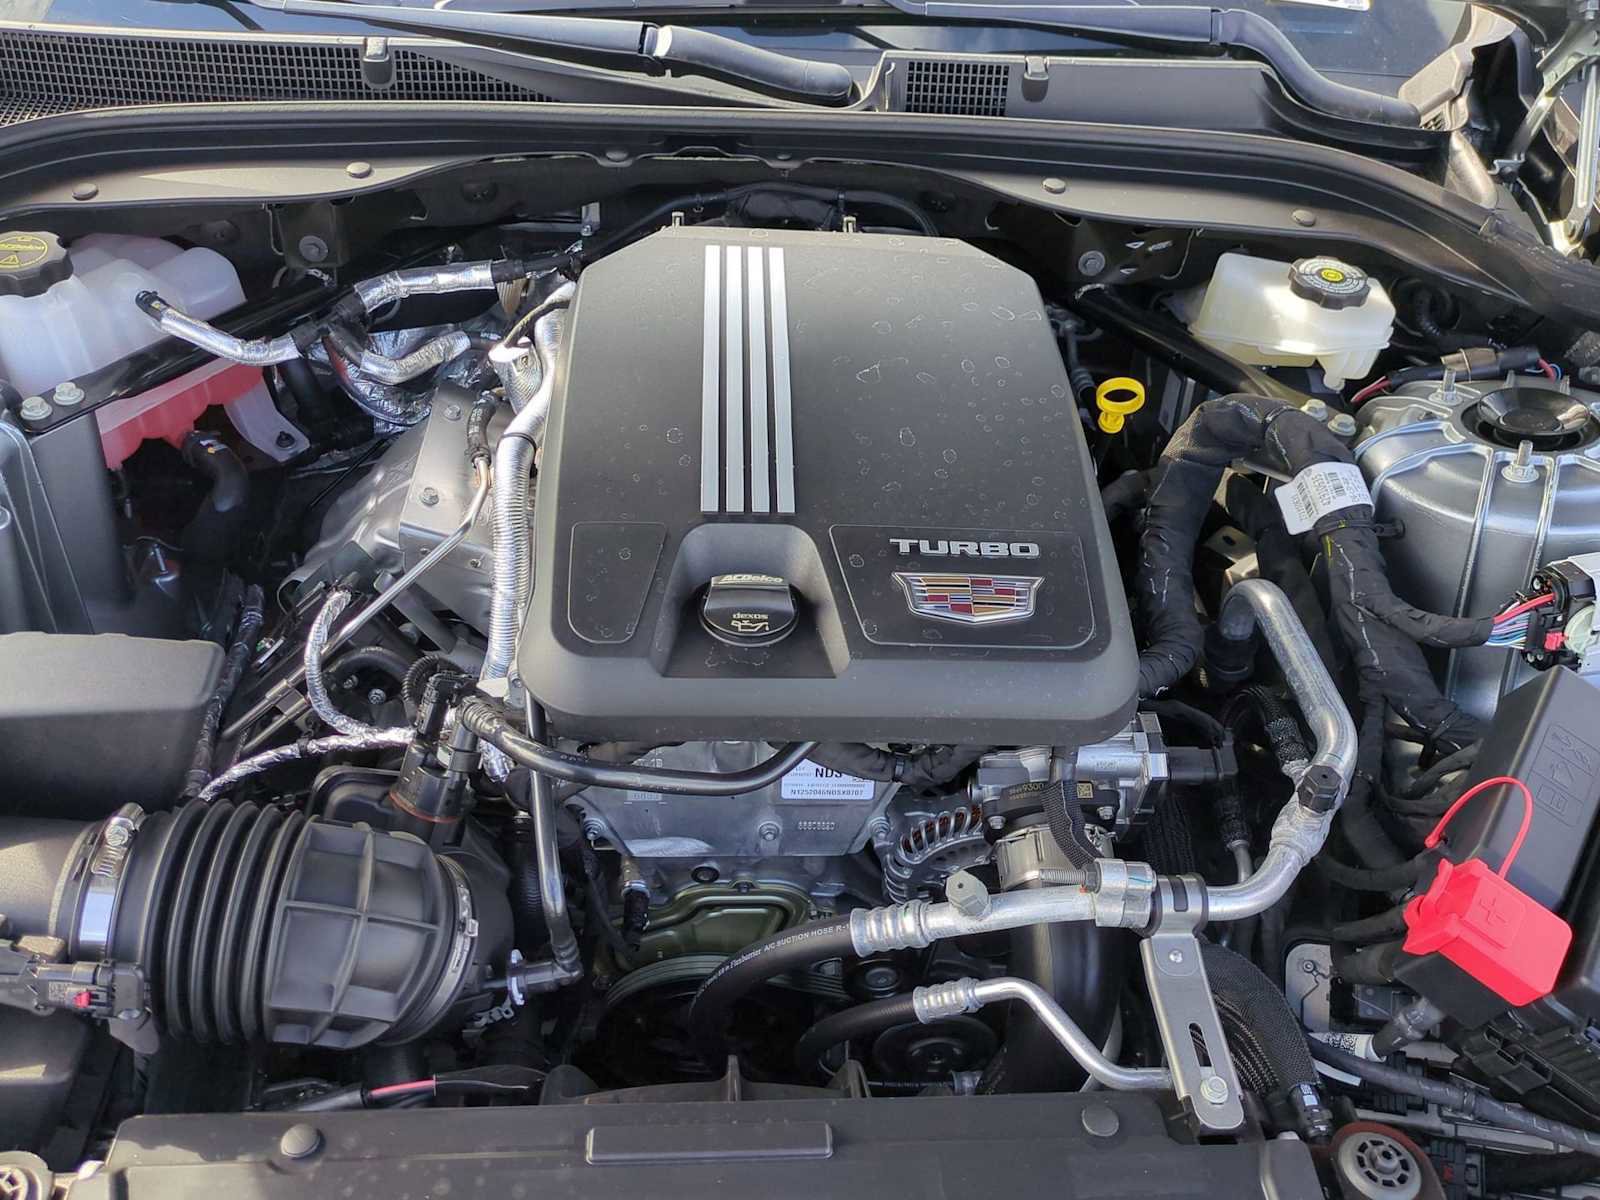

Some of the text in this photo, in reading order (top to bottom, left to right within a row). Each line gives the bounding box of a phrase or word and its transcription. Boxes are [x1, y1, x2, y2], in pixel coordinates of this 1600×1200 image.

[889, 538, 1040, 558] TURBO
[720, 574, 784, 584] ACDelco
[732, 612, 769, 620] dexos
[776, 932, 810, 947] SUCTION
[811, 925, 834, 936] HOSE
